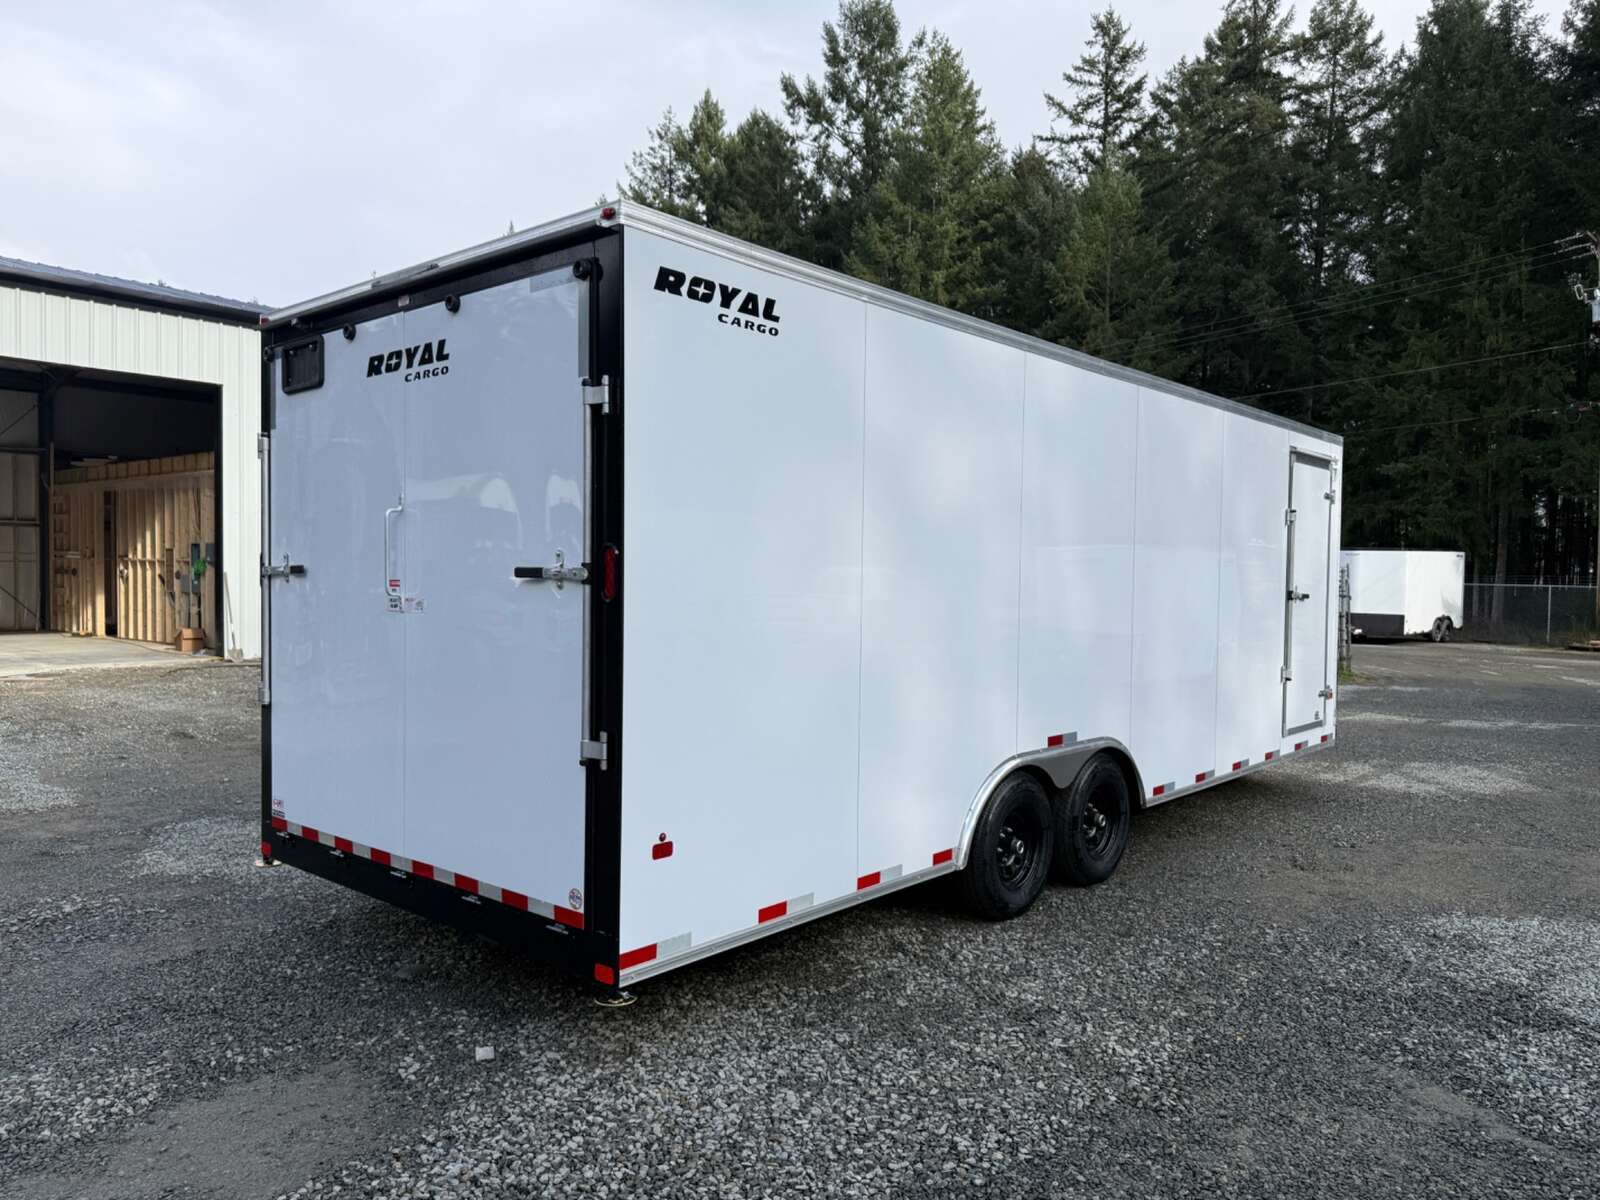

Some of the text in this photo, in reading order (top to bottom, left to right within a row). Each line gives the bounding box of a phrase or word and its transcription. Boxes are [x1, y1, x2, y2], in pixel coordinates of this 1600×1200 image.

[654, 266, 781, 323] ROYAL
[718, 314, 779, 337] CARGO
[366, 339, 450, 379] ROYAL
[404, 366, 449, 383] CARGO
